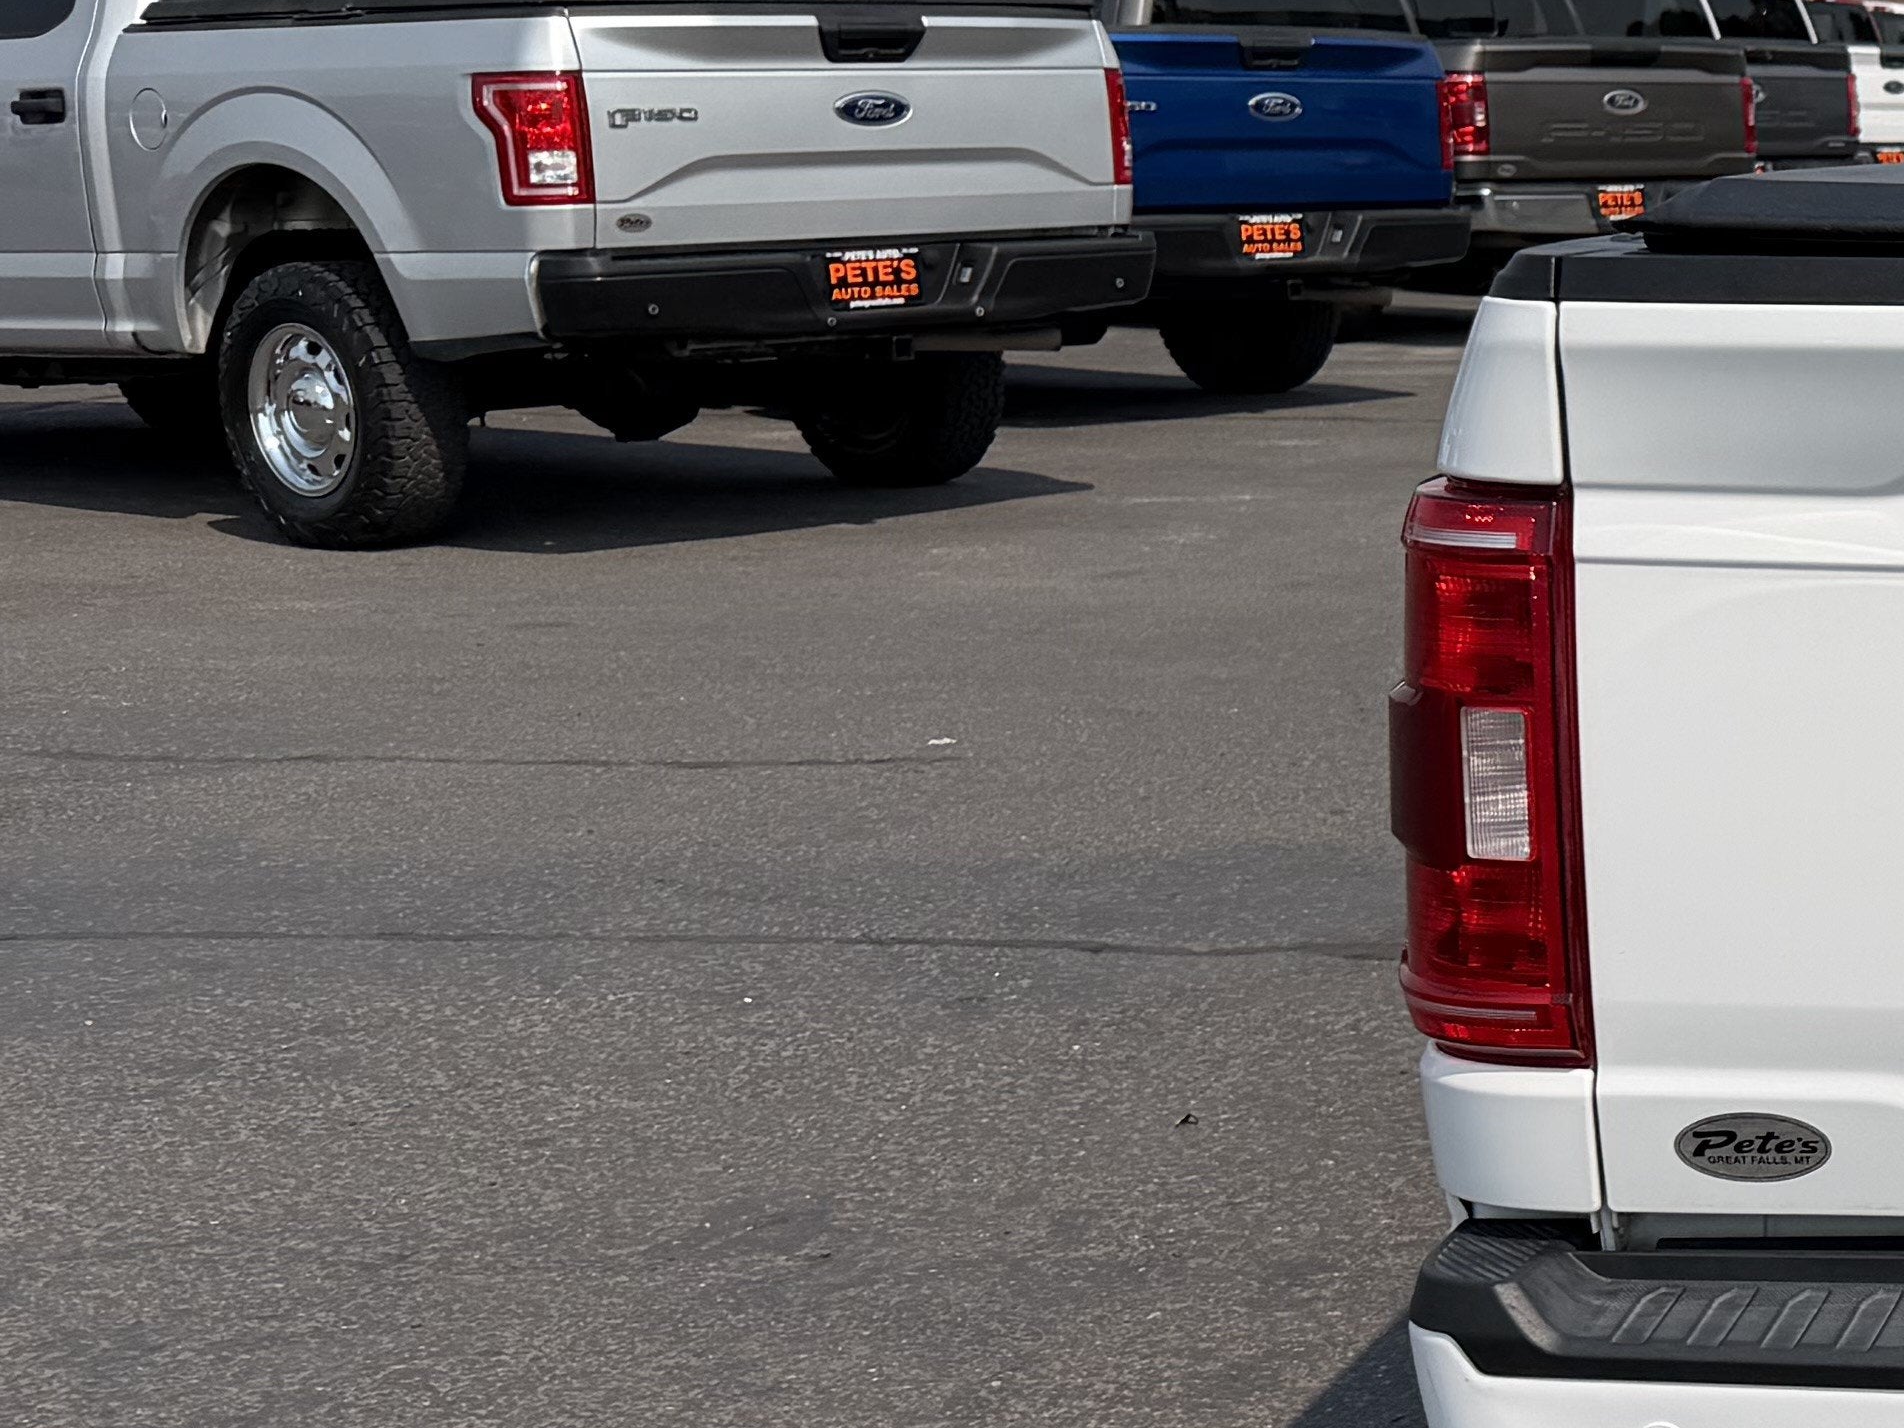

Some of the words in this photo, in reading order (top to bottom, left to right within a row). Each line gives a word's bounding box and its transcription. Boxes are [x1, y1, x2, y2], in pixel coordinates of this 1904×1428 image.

[855, 98, 896, 119] Ford
[1240, 223, 1301, 241] PETE'S
[829, 258, 917, 284] PETE'S
[832, 286, 871, 300] AUTO
[874, 283, 919, 297] SALES
[1692, 1129, 1820, 1158] Pete's
[1707, 1155, 1747, 1166] GREAT
[1751, 1155, 1792, 1166] FALLS,
[1795, 1155, 1812, 1165] MT
